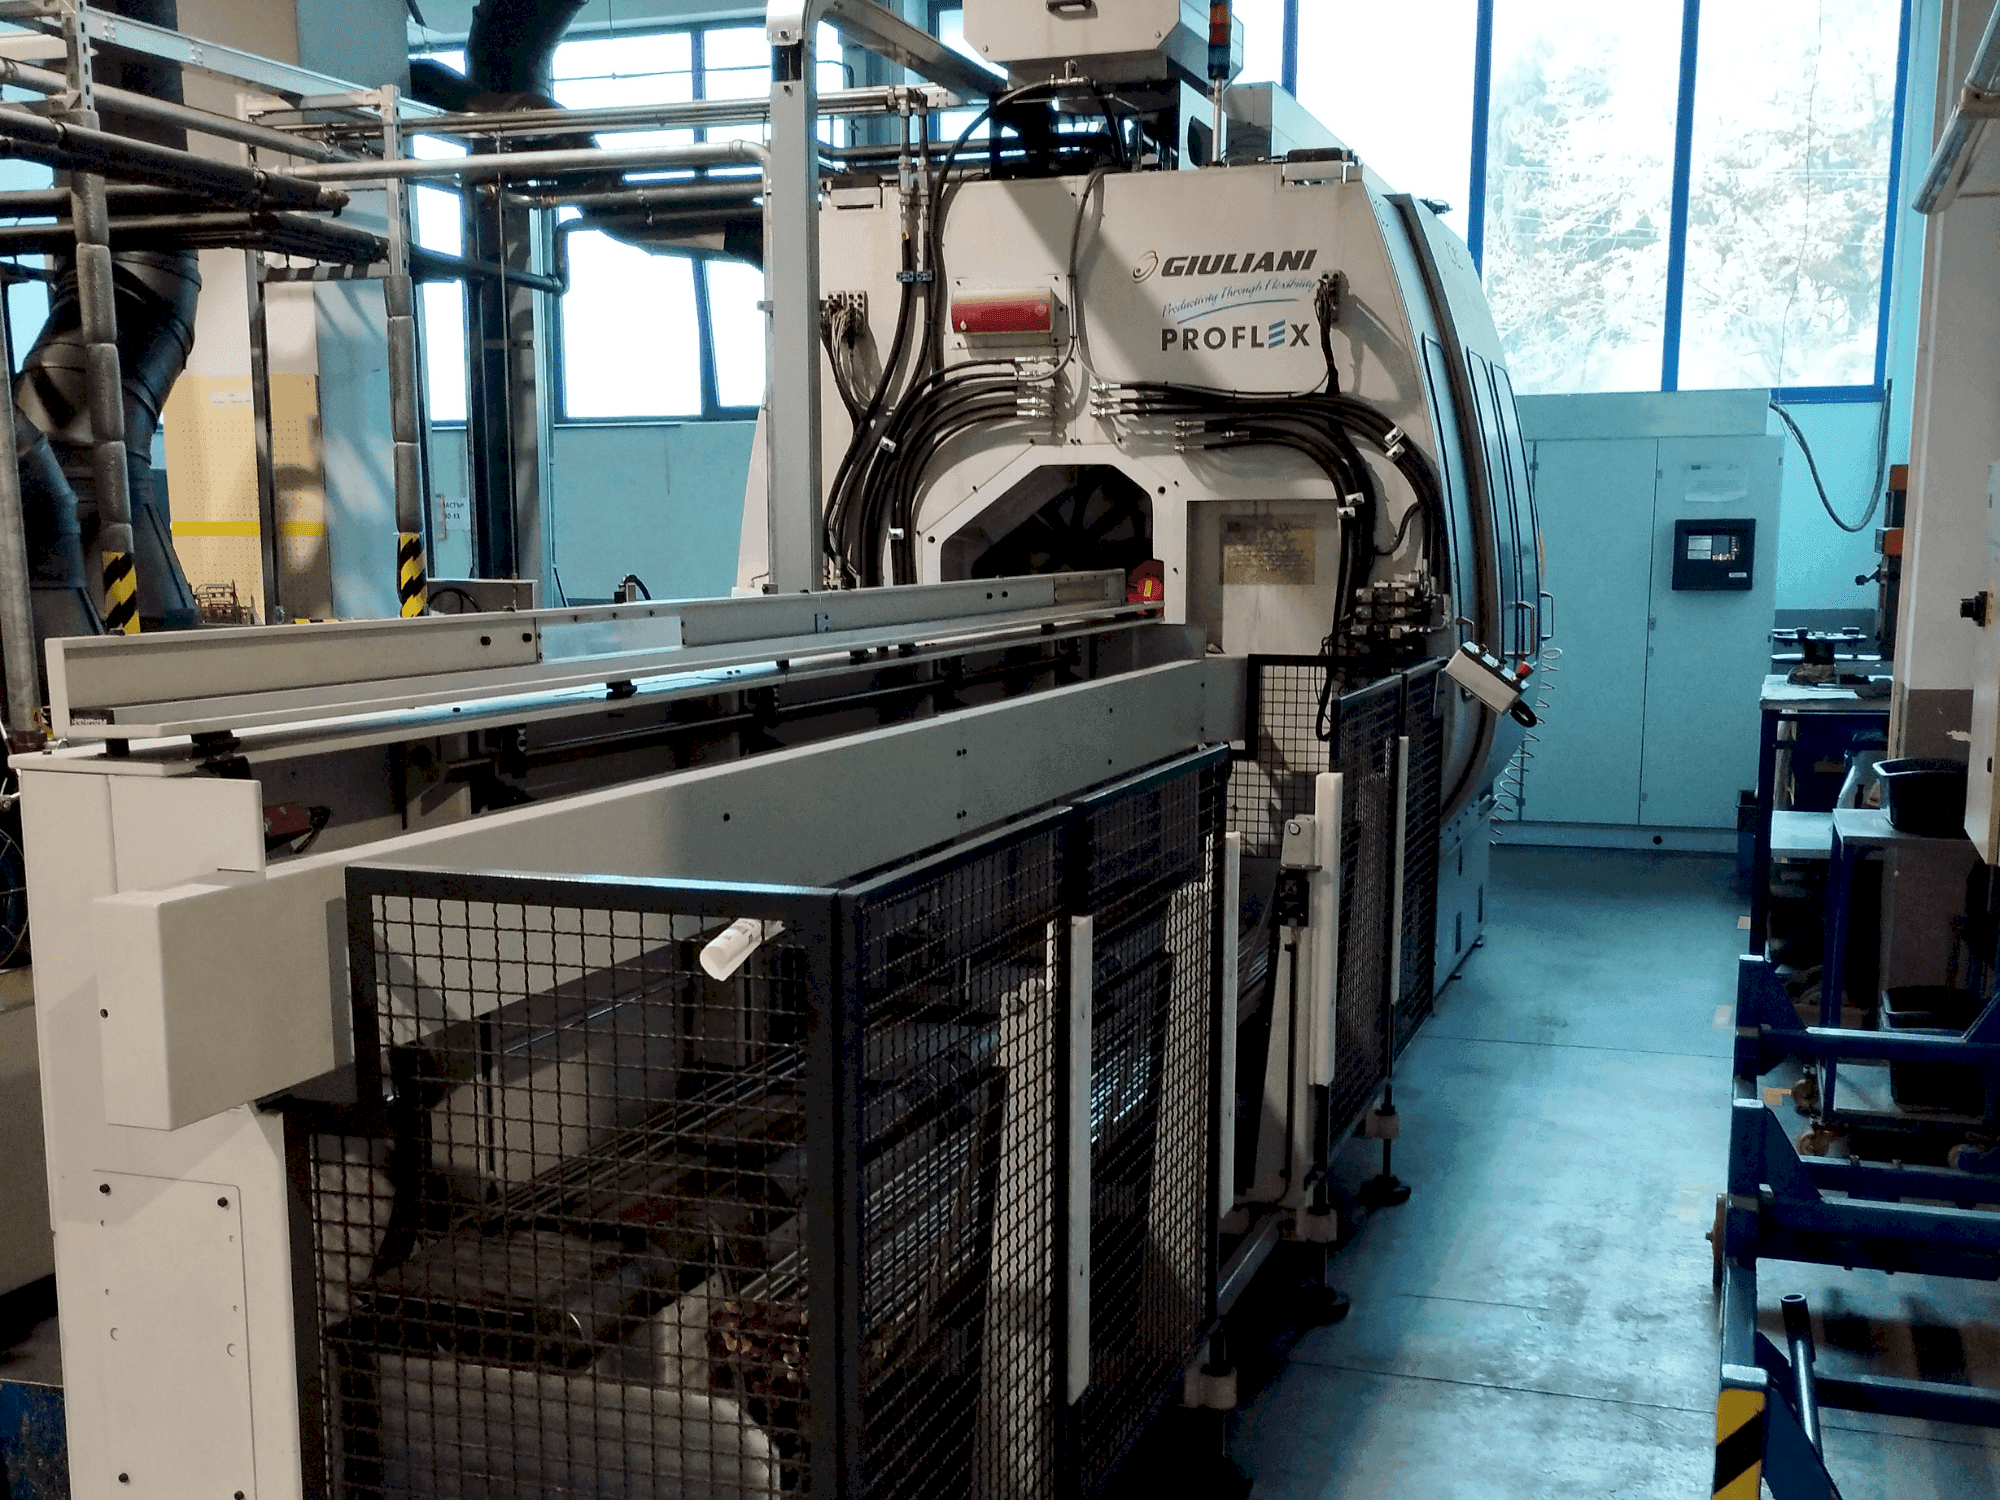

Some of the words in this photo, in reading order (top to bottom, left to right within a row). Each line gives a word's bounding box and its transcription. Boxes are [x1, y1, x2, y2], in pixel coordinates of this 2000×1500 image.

[1161, 249, 1318, 277] GIULIANI
[1220, 281, 1262, 299] Through
[1161, 320, 1310, 351] PROFLEX
